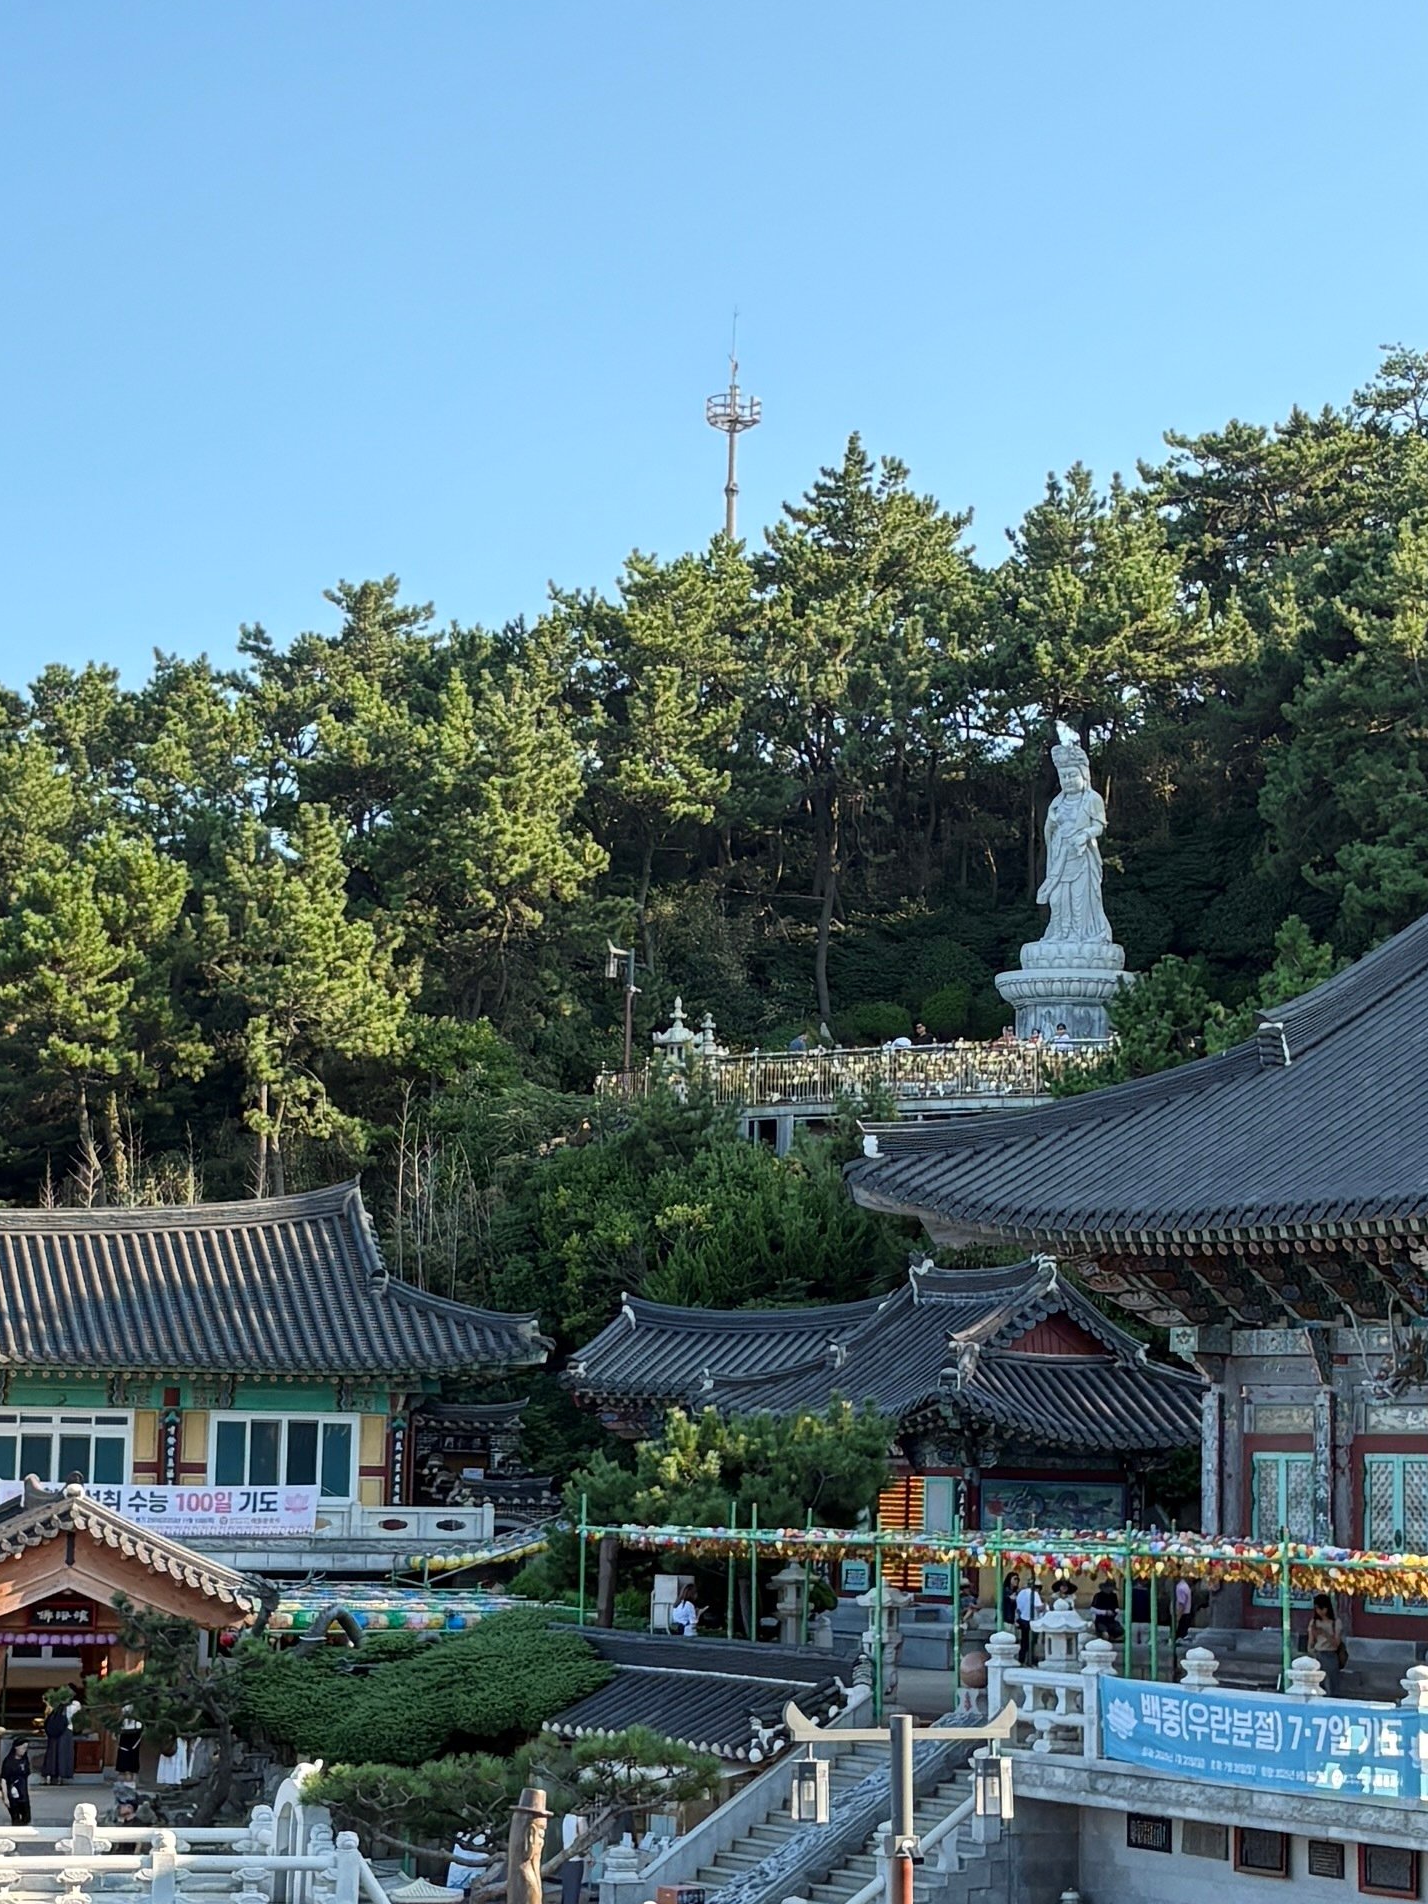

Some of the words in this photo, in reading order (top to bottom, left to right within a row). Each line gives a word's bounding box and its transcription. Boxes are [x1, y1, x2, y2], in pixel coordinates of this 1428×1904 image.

[127, 1490, 169, 1514] 수능
[174, 1491, 233, 1514] 100일
[238, 1490, 279, 1513] 기도
[1140, 1693, 1283, 1753] 백중(우란분절)
[1357, 1717, 1405, 1758] 기도
